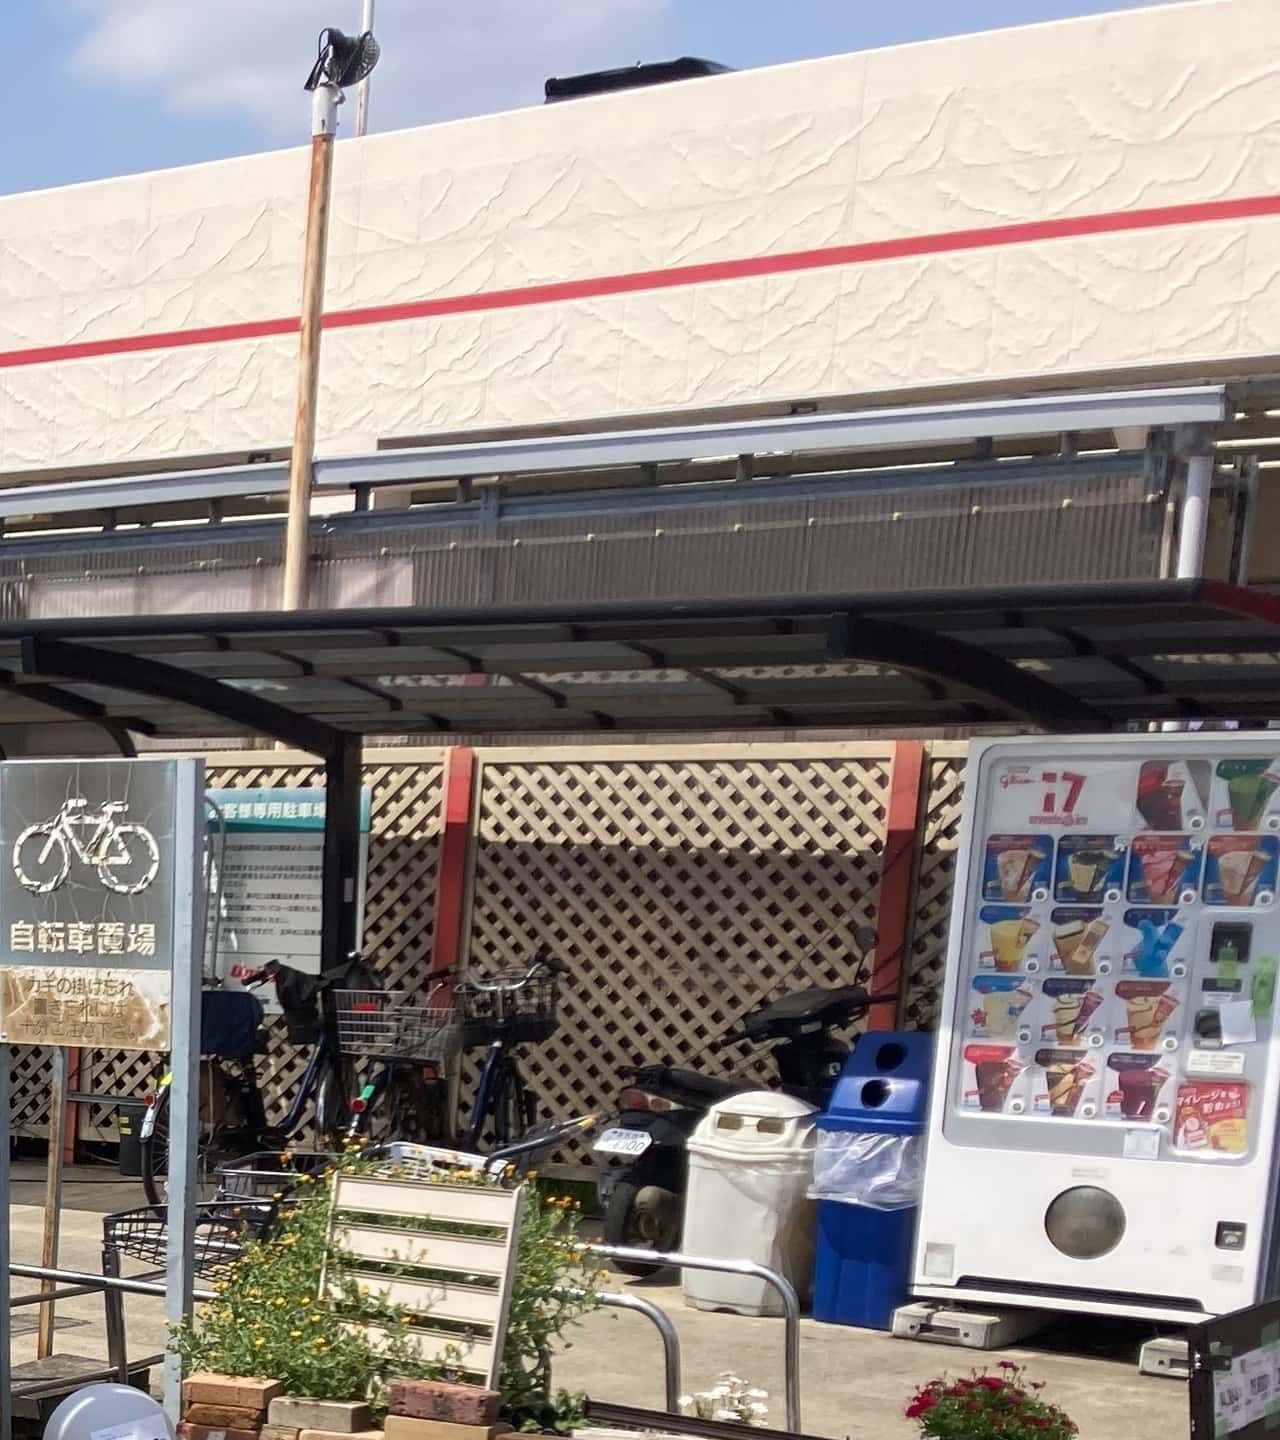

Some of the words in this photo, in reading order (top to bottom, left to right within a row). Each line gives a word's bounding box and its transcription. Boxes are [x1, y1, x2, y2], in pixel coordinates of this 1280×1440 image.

[10, 920, 156, 956] 自転車置場
